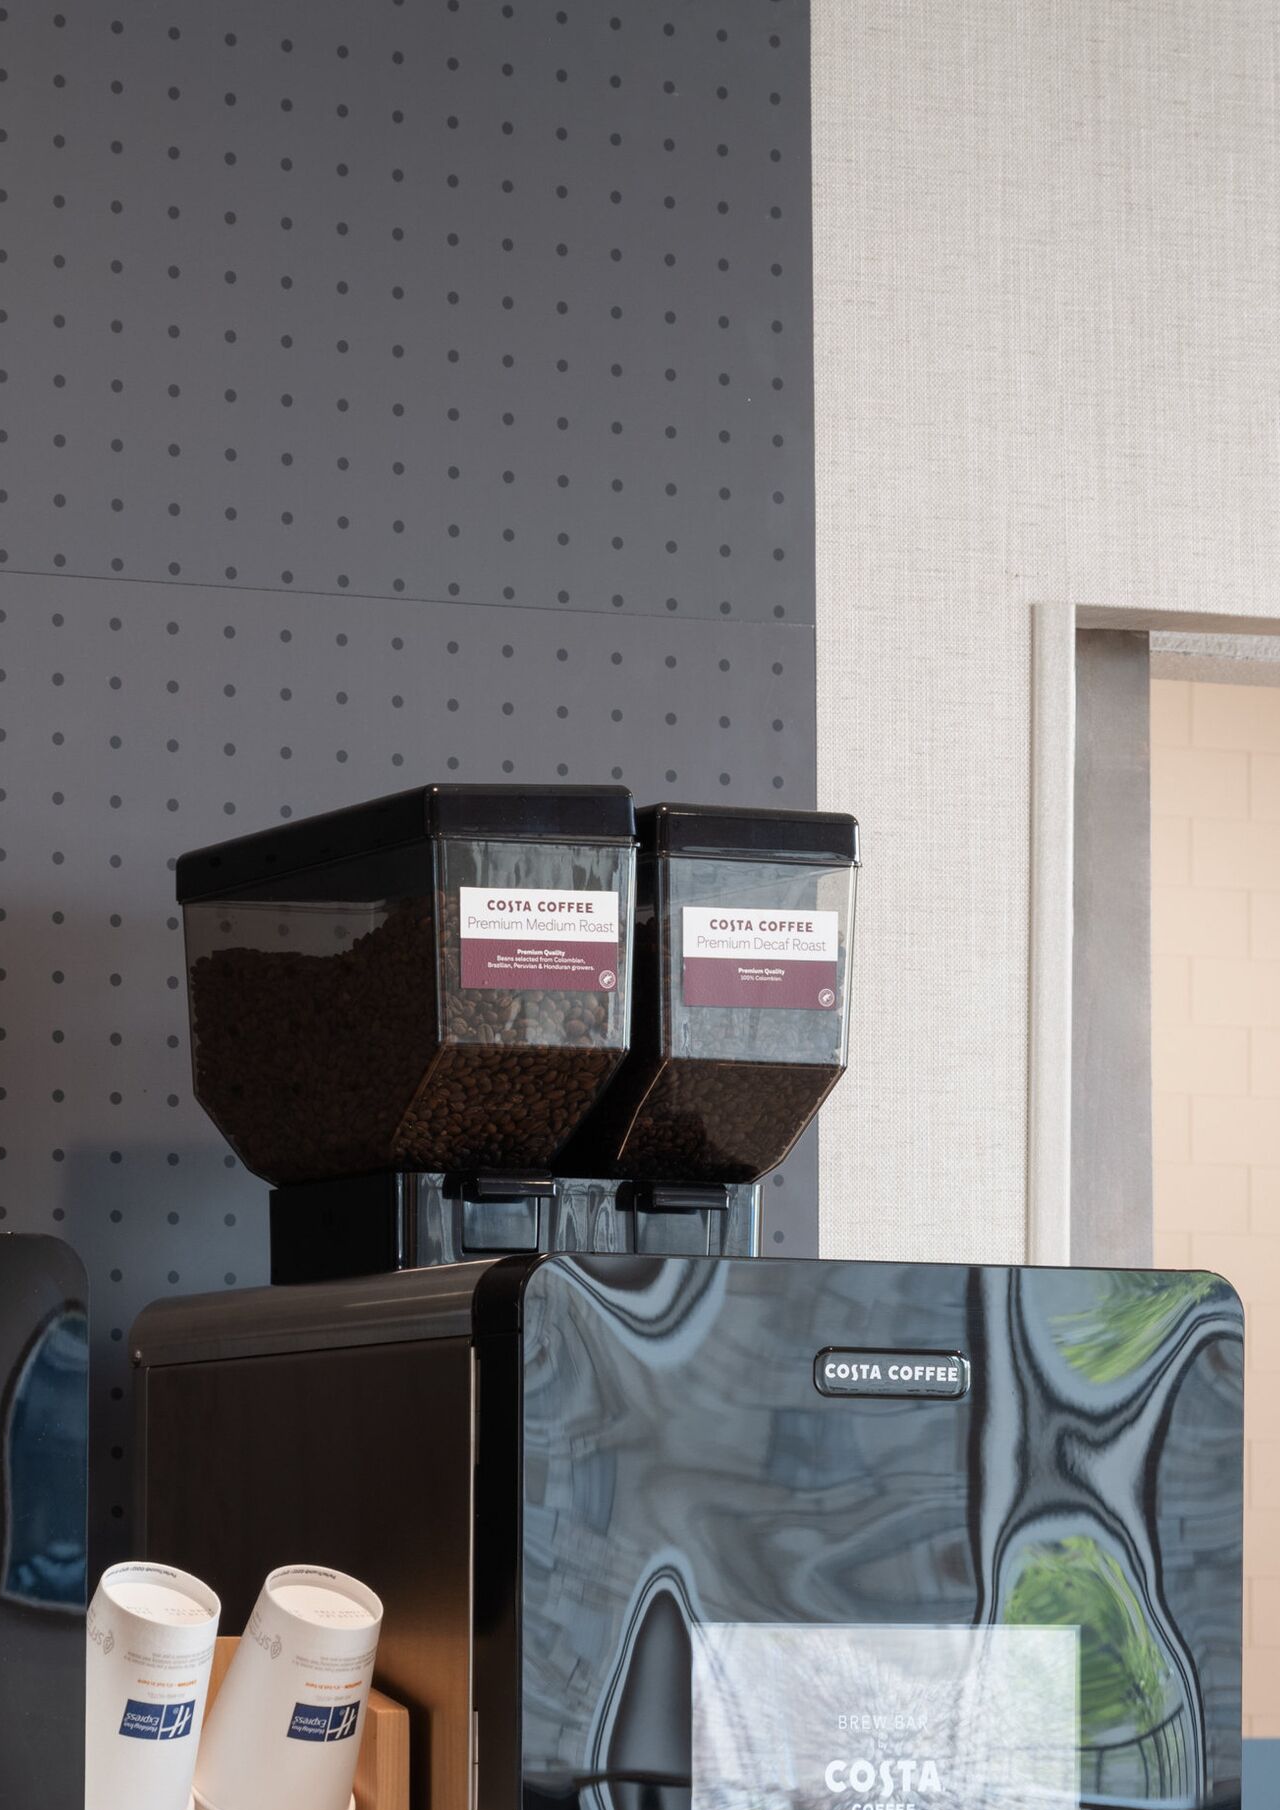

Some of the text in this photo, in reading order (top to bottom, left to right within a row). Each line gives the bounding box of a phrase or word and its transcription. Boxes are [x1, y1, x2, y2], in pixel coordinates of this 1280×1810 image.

[487, 900, 594, 913] COSTA COFFEE
[468, 916, 614, 933] Premium Medium Roast
[710, 919, 813, 933] COSTA COFFEE
[697, 935, 826, 952] Premium Decaf Roast
[544, 949, 565, 957] Quality
[764, 968, 785, 976] Quality
[825, 1362, 958, 1382] COSTA COFFEE
[839, 1715, 928, 1730] BREW BAR
[825, 1760, 942, 1797] COSTA
